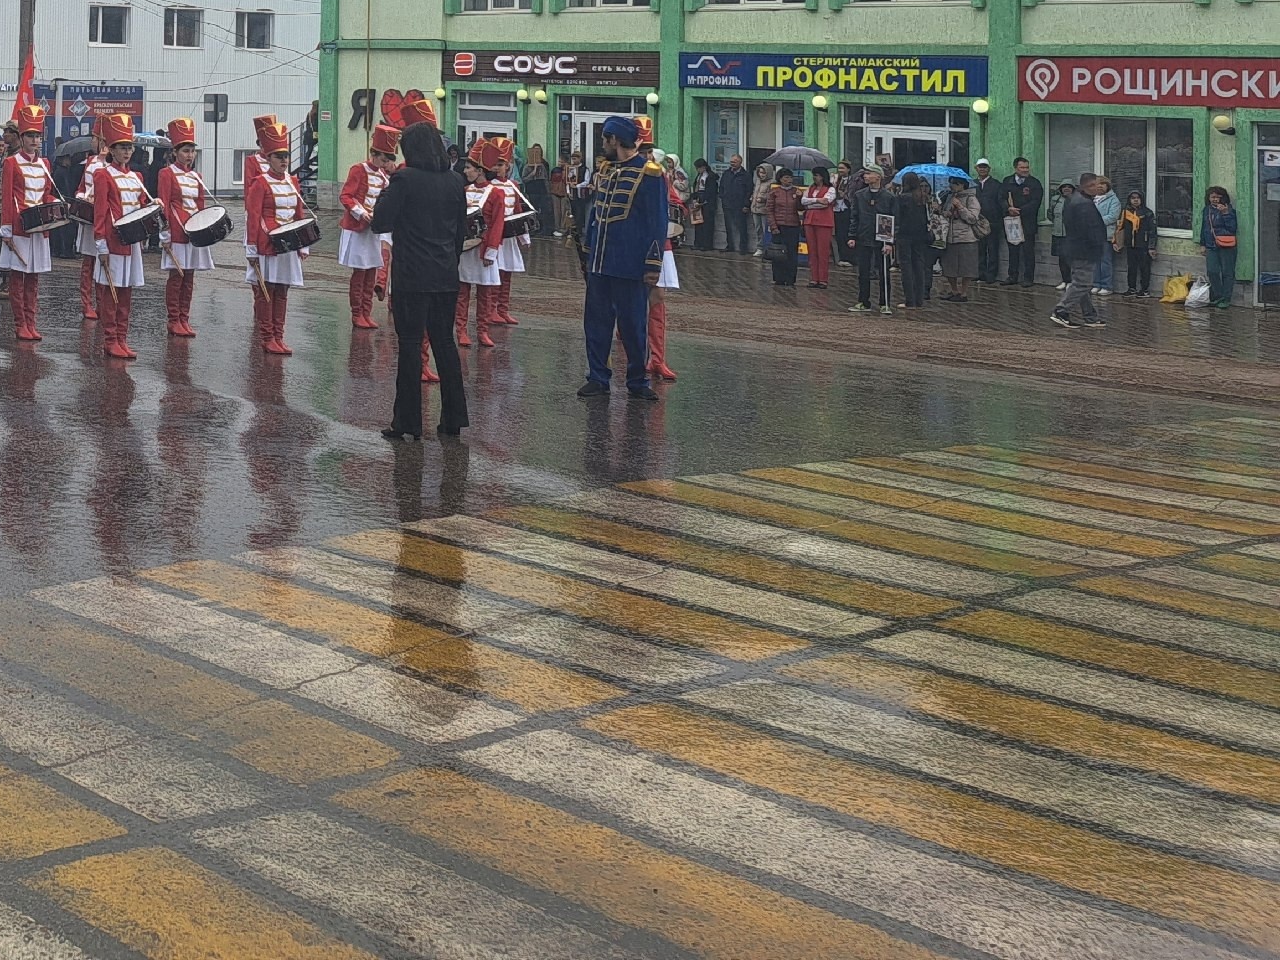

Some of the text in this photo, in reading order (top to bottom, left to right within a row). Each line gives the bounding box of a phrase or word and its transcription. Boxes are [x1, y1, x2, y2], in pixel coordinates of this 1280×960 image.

[493, 54, 579, 75] СОУС
[793, 56, 920, 67] СТЕРЛИТАМАКСКИЙ
[687, 75, 742, 86] М-ПРОФИЛЬ
[756, 66, 965, 93] ПРОФНАСТИЛ
